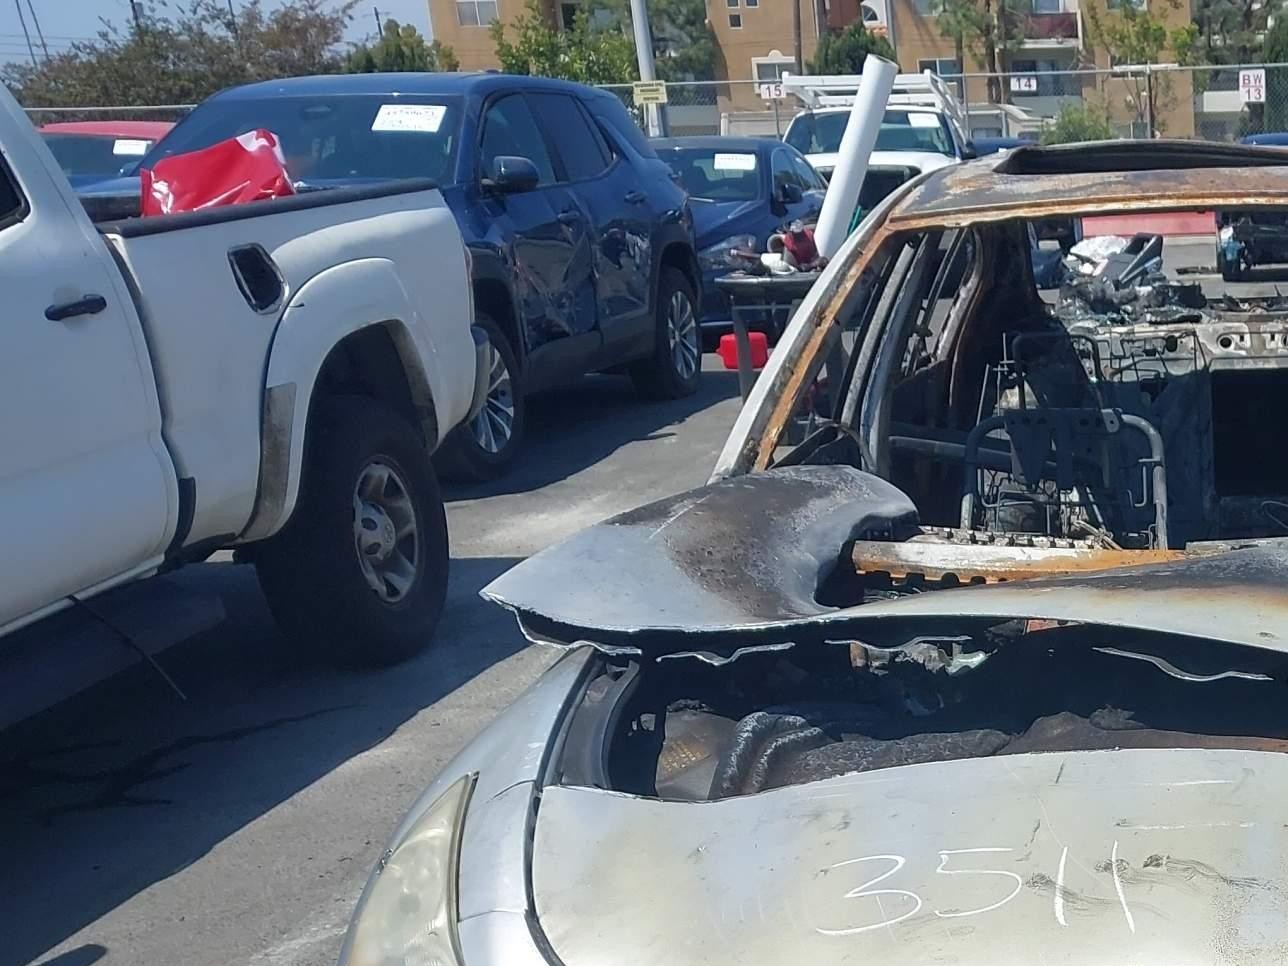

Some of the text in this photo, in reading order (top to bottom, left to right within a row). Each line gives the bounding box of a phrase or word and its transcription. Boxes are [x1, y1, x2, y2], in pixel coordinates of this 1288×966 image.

[1015, 77, 1032, 89] 14
[1242, 73, 1262, 85] BW
[765, 84, 782, 97] 15
[1245, 87, 1262, 101] 13
[814, 838, 1136, 936] 3511
